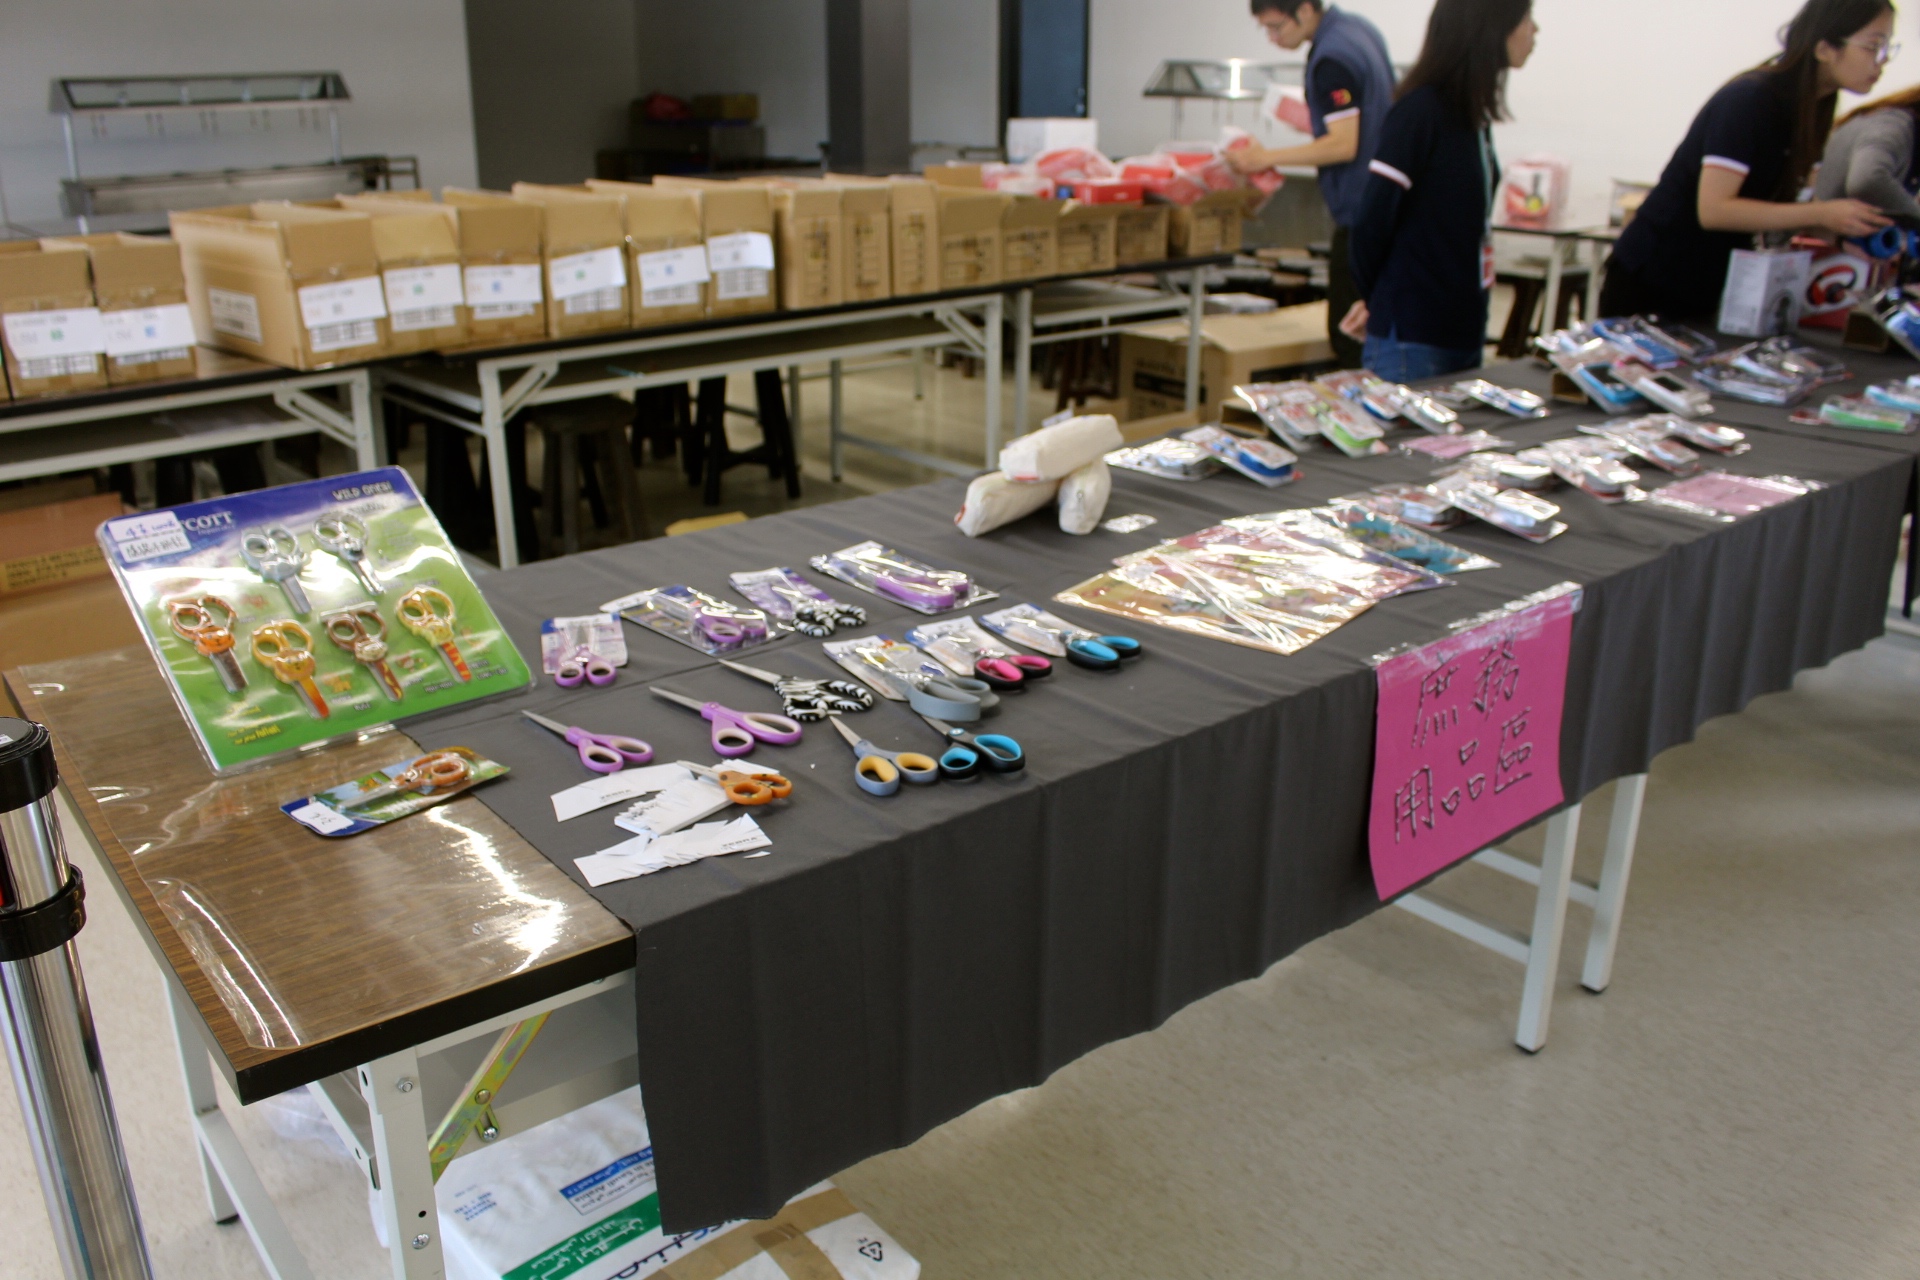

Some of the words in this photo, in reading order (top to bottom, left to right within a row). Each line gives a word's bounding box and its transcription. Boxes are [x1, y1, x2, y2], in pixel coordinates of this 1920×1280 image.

[1411, 627, 1521, 748] 庶務
[1394, 705, 1535, 844] 用品區
[573, 1181, 605, 1203] Arabia
[607, 1170, 634, 1188] Saudi
